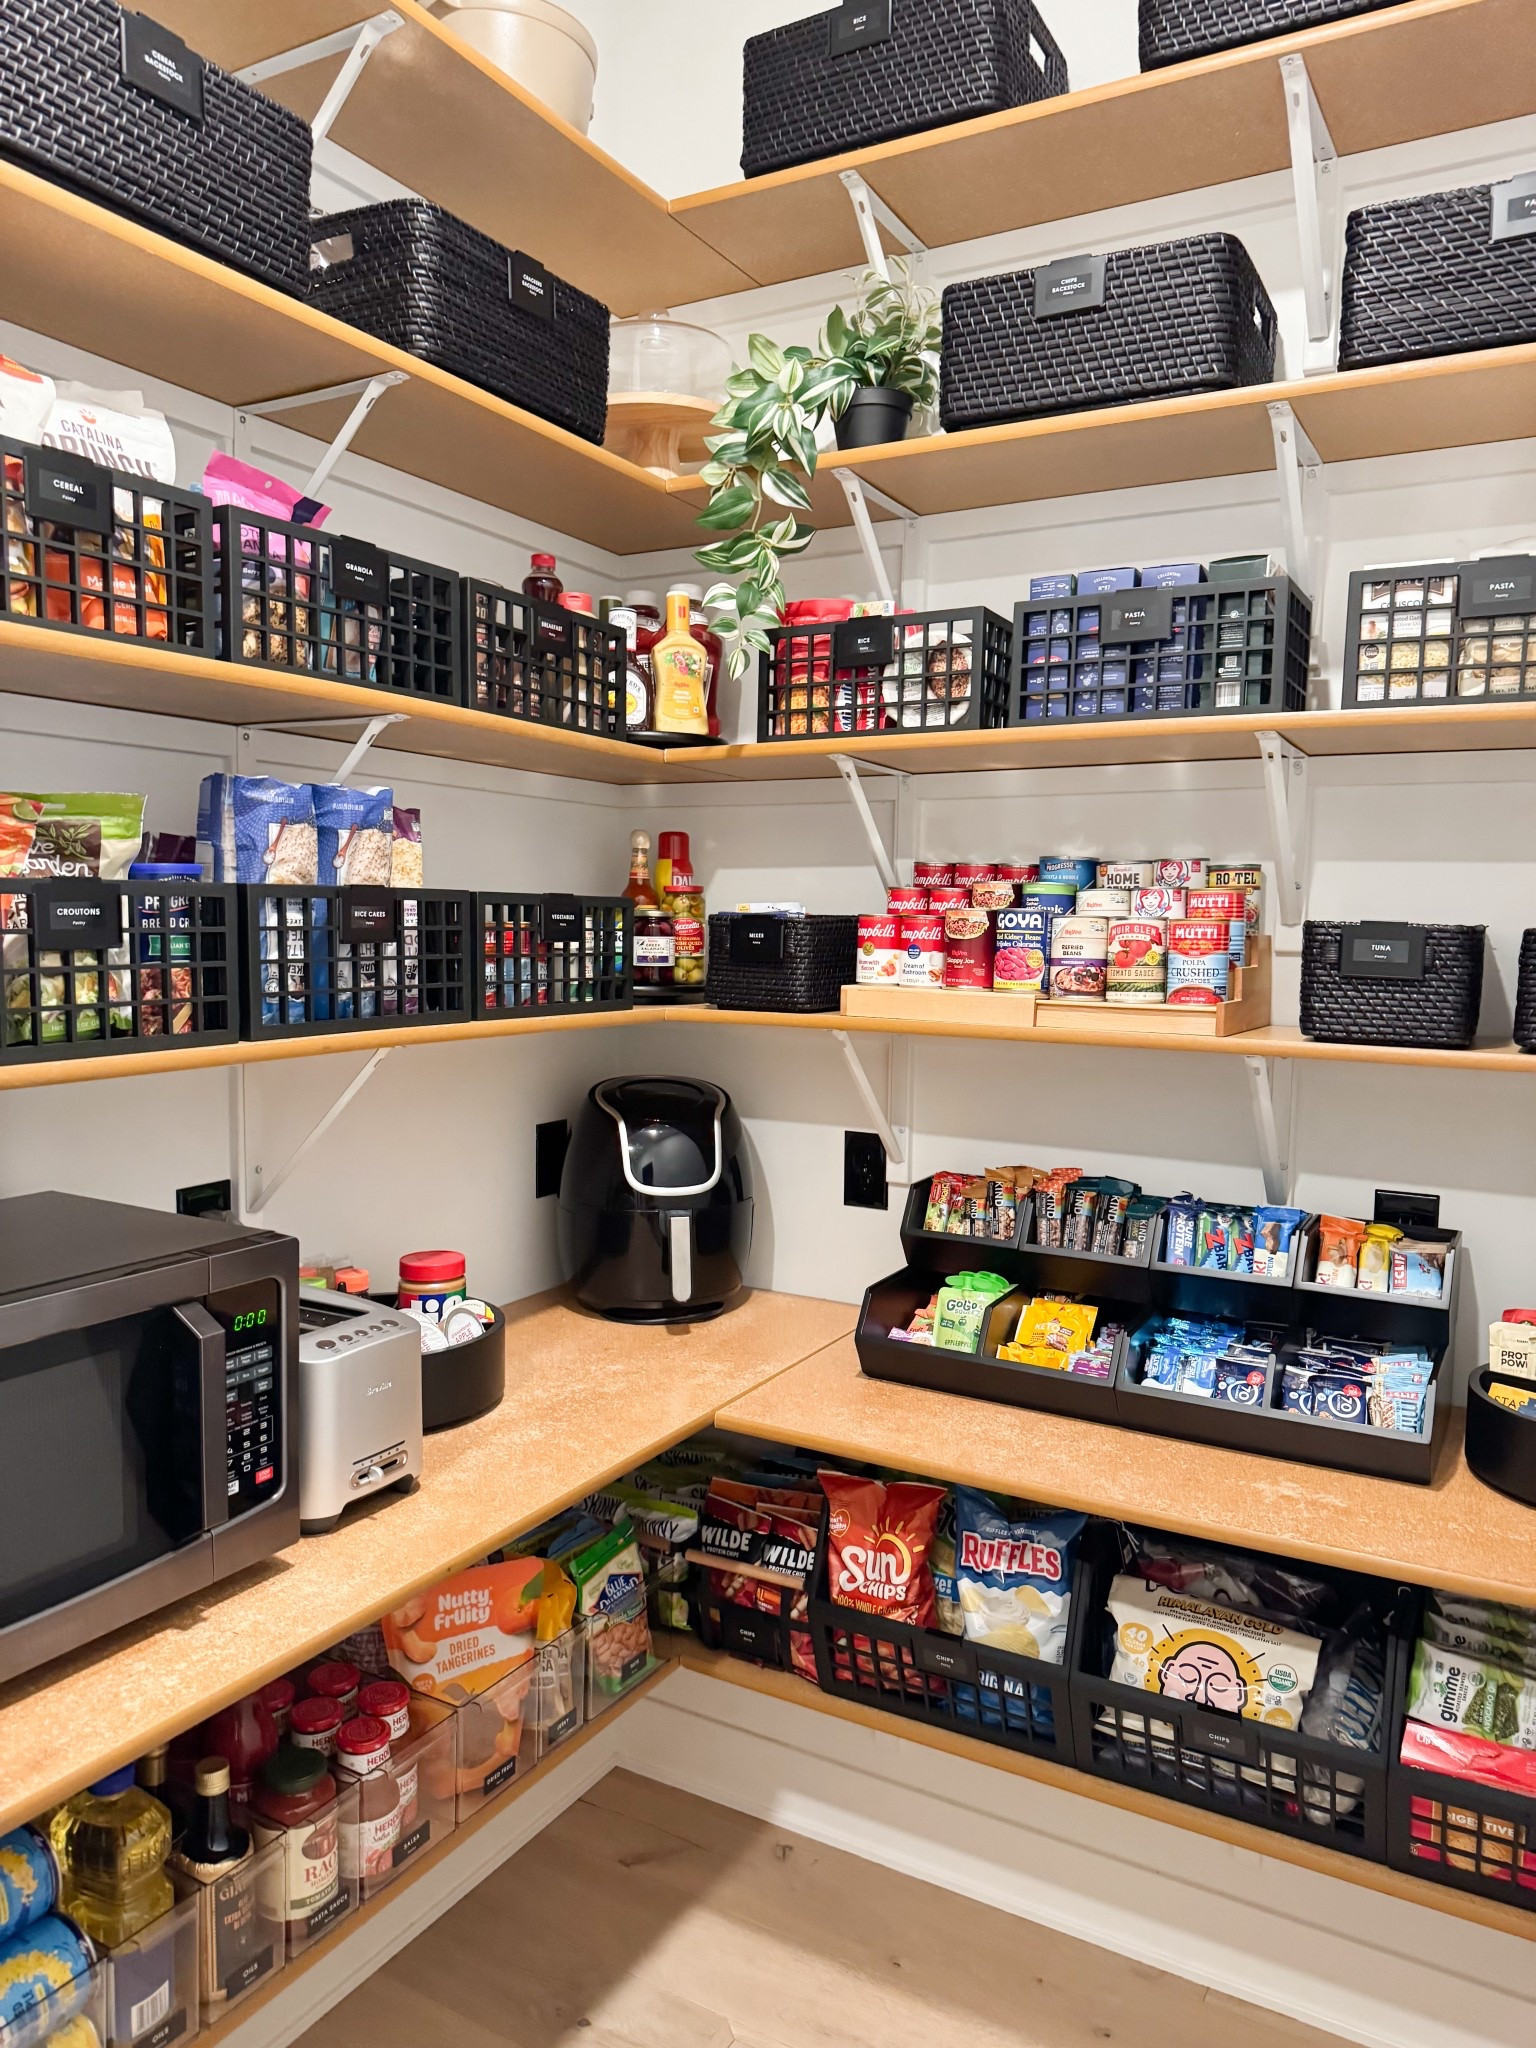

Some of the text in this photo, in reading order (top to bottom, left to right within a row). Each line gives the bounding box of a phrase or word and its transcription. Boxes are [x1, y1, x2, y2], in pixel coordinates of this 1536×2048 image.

[853, 14, 867, 25] RICE
[151, 49, 177, 71] CEREAL
[144, 53, 184, 84] BACKSTOCK
[521, 279, 544, 295] BACKSTOCK
[1051, 282, 1086, 294] BACKSTOCK
[1060, 276, 1078, 285] CHIPS
[60, 419, 124, 452] CATALINA
[53, 479, 85, 495] CEREAL
[345, 562, 374, 576] GRANOLA
[1489, 582, 1515, 591] PASTA
[1124, 610, 1146, 619] PASTA
[541, 620, 563, 633] BREAKFAST
[857, 636, 871, 645] RICE
[865, 681, 876, 731] WHTE
[1046, 861, 1074, 871] PROGRESSO
[1107, 873, 1140, 885] HOME
[1189, 897, 1229, 908] MUTTI
[56, 907, 101, 916] CROUTONS
[354, 910, 386, 918] RICE CAKES
[551, 913, 575, 921] VEGETABLES
[142, 917, 176, 928] BRED
[997, 913, 1042, 929] GOYA
[857, 923, 895, 939] ampbell's
[1004, 934, 1023, 942] Kidney
[1111, 924, 1157, 937] MUIR GLEN
[1175, 928, 1218, 939] MUTTI
[946, 957, 963, 965] Sloppy
[1110, 969, 1155, 977] TOMATO SAUCE
[1170, 967, 1220, 977] CRUSHED
[994, 1181, 1004, 1207] KIND
[970, 1199, 978, 1219] KIND
[1046, 1190, 1056, 1219] KIND
[1074, 1190, 1087, 1215] KIND
[1107, 1195, 1121, 1222] KIND
[1137, 1219, 1148, 1242] KIND
[1174, 1211, 1188, 1256] PROTEIN
[1184, 1221, 1194, 1249] PURE
[1204, 1228, 1228, 1270] Z BAR
[1233, 1233, 1255, 1255] Z
[1394, 1252, 1405, 1279] CLIF
[410, 1294, 463, 1324] Jif
[946, 1299, 978, 1312] GoGo
[455, 1328, 473, 1344] APPLE
[1034, 1323, 1060, 1334] KETO
[1238, 1385, 1251, 1400] 70
[1340, 1396, 1353, 1412] 70
[261, 1421, 267, 1430] 3
[227, 1459, 233, 1467] 7
[701, 1525, 752, 1552] WILDE
[707, 1545, 739, 1558] PROTEIN CHIPS
[764, 1543, 816, 1571] WILDE
[961, 1531, 1063, 1581] RUFFLES
[768, 1564, 806, 1578] PROTEIN CHIPS
[599, 1577, 639, 1610] DIAMOND
[604, 1575, 628, 1597] BLUE
[858, 1581, 907, 1601] CHIPS
[438, 1588, 491, 1613] Nutty
[837, 1594, 877, 1615] 100% WHOLE
[1157, 1595, 1285, 1636] HIMALAYAN GOLD
[1169, 1608, 1266, 1638] PREMIUM QUALITY, MINIMALLY PROCESSED
[739, 1628, 756, 1638] CHIPS
[1126, 1626, 1148, 1642] 40
[1164, 1611, 1182, 1621] BUTTER
[1182, 1616, 1206, 1626] FLAVORED
[1206, 1621, 1230, 1633] COCONUT
[1269, 1638, 1282, 1647] SALT
[449, 1636, 480, 1656] DRIED
[436, 1643, 496, 1676] TANGERINES
[935, 1654, 954, 1664] CHIPS
[1271, 1676, 1293, 1687] ORGANIC
[1274, 1668, 1292, 1679] USDA
[1459, 1672, 1467, 1691] SEAWEED
[1439, 1666, 1461, 1723] gimme
[1484, 1695, 1494, 1732] AVOCADO
[556, 1717, 570, 1730] JERKY
[1208, 1732, 1230, 1744] CHIPS
[486, 1761, 514, 1786] DRIED FRUIT
[1447, 1811, 1514, 1838] IGETIVE
[403, 1833, 420, 1850] SALSA
[310, 1893, 348, 1927] PASTA SAUCE
[242, 1962, 259, 1978] OILS
[151, 2026, 169, 2044] OILS
